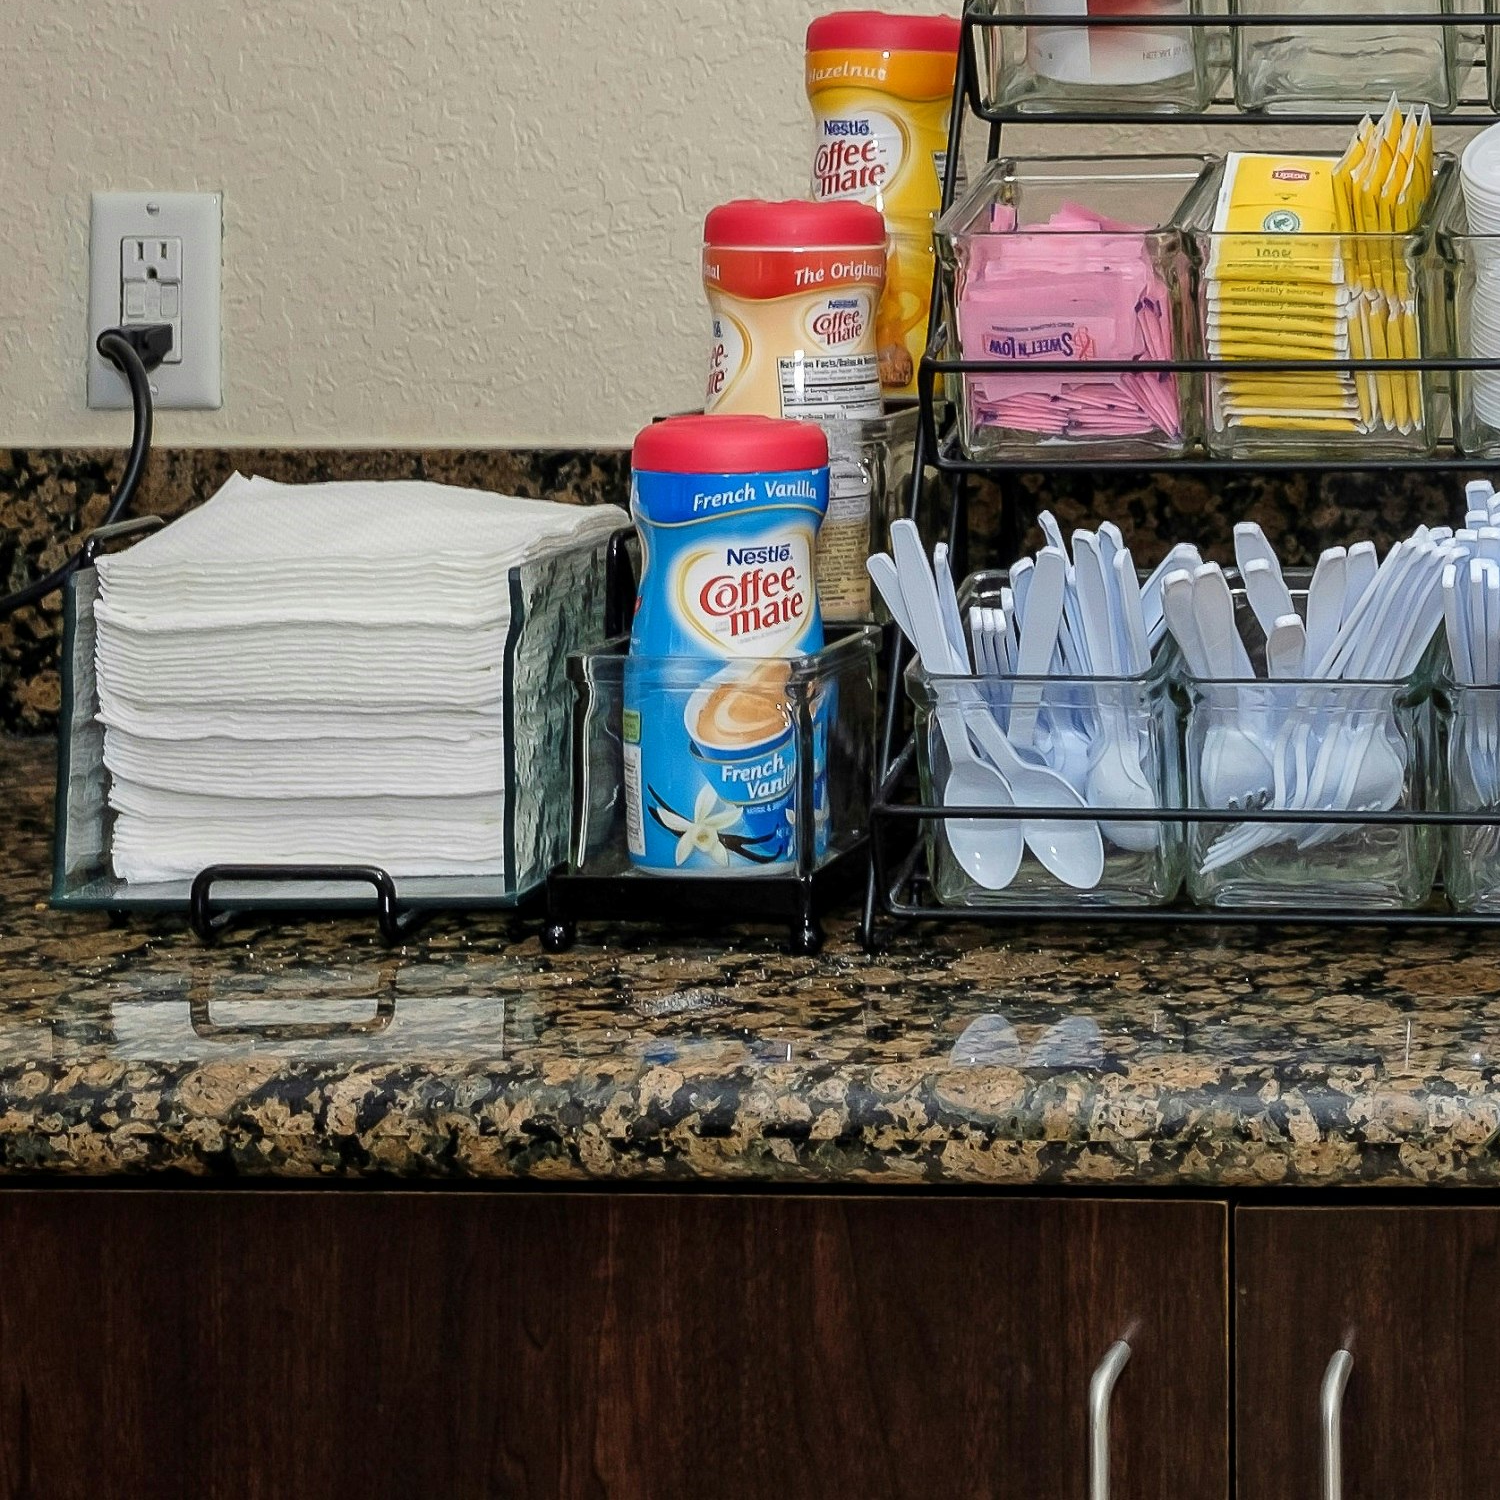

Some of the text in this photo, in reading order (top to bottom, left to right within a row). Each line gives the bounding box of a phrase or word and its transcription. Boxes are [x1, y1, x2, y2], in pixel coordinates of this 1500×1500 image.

[821, 164, 886, 197] mate
[794, 260, 882, 286] The Original
[827, 323, 862, 345] mate
[692, 480, 817, 512] French Vanilla
[729, 591, 803, 637] mate
[722, 753, 785, 782] French
